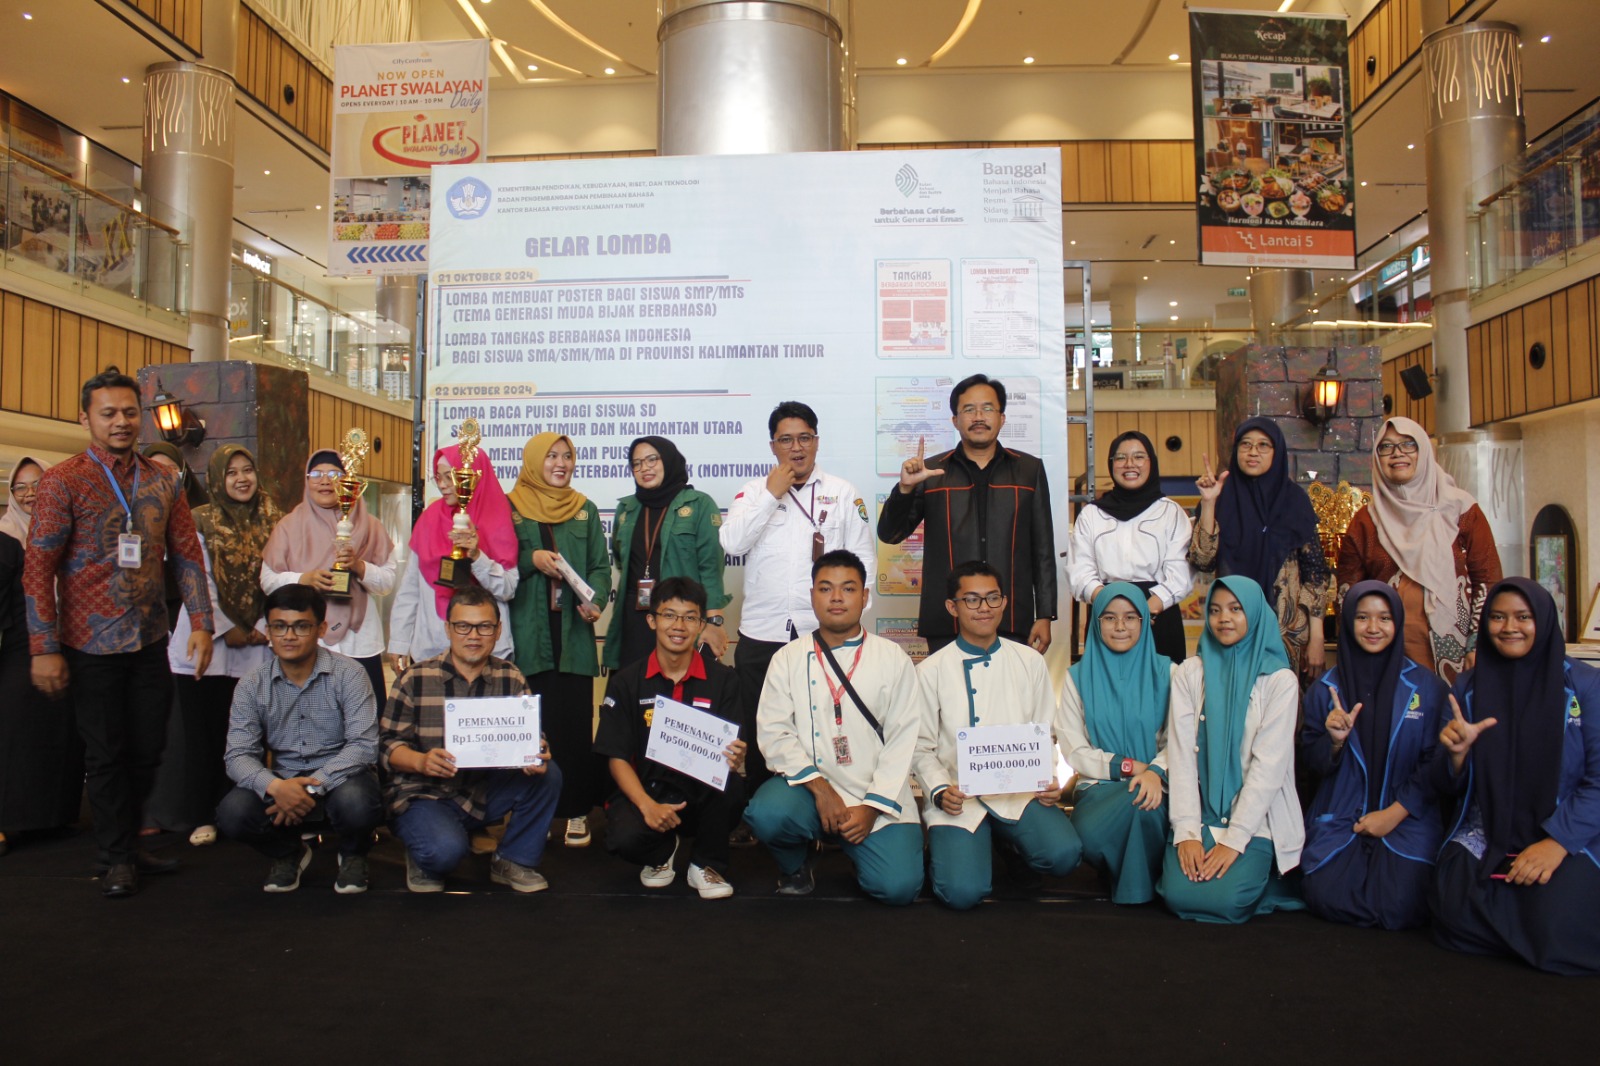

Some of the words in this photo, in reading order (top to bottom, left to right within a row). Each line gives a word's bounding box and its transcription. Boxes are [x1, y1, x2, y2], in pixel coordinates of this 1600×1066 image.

[1255, 30, 1287, 41] Kecapi
[377, 71, 408, 81] NOW
[412, 69, 444, 80] OPEN
[341, 83, 398, 98] PLANET
[400, 79, 483, 96] SWALAYAN
[450, 90, 482, 113] Daily
[402, 121, 466, 144] PLANET
[403, 145, 438, 153] SWALAYAN
[438, 142, 467, 157] Daily
[982, 162, 1046, 178] Bangga!
[497, 184, 541, 192] KEMENTERIAN
[542, 183, 581, 191] PENDIDIKAN,
[582, 182, 627, 190] KEBUDAYAAN,
[983, 187, 1012, 195] Menjadi
[521, 194, 573, 202] PENGEMBANGAN
[589, 192, 626, 200] PEMBINAAN
[497, 206, 523, 214] KANTOR
[551, 204, 581, 212] PROVINSI
[582, 203, 623, 211] KALIMANTAN
[983, 206, 1008, 215] Sidang
[874, 216, 900, 224] untuk
[902, 215, 938, 224] Generasi
[940, 215, 964, 223] Emas
[1285, 219, 1324, 227] Nusantara
[525, 236, 590, 258] GELAR
[596, 233, 672, 256] LOMBA
[1260, 234, 1302, 247] Lantai
[1305, 236, 1314, 247] 5
[438, 273, 452, 283] 21
[453, 272, 502, 282] OKTOBER
[504, 271, 533, 281] 2024
[893, 271, 932, 281] TANGKAS
[446, 290, 488, 306] LOMBA
[491, 289, 554, 305] MEMBUAT
[557, 288, 604, 302] POSTER
[607, 287, 636, 302] BAGI
[640, 286, 680, 301] SISWA
[684, 285, 744, 301] SMP/MTs
[452, 307, 492, 323] (TEMA
[494, 306, 553, 321] GENERASI
[557, 305, 594, 320] MUDA
[598, 304, 635, 318] BIJAK
[638, 302, 717, 318] BERBAHASA)
[445, 331, 487, 346] LOMBA
[491, 330, 545, 345] TANGKAS
[549, 329, 621, 344] BERBAHASA
[625, 328, 691, 342] INDONESIA
[452, 349, 480, 364] BAGI
[484, 348, 524, 364] SISWA
[527, 346, 615, 363] SMA/SMK/MA
[620, 347, 632, 361] DI
[636, 346, 694, 360] PROVINSI
[698, 344, 779, 360] KALIMANTAN
[783, 343, 824, 358] TIMUR
[435, 387, 451, 396] 22
[452, 385, 501, 396] OKTOBER
[503, 385, 532, 395] 2024
[444, 406, 485, 420] LOMBA
[490, 406, 521, 419] BACA
[526, 405, 558, 418] PUISI
[562, 404, 591, 418] BAGI
[596, 404, 636, 418] SISWA
[640, 403, 656, 417] SD
[546, 422, 586, 436] TIMUR
[591, 422, 615, 436] DAN
[620, 422, 699, 435] KALIMANTAN
[703, 421, 742, 434] UTARA
[602, 446, 630, 460] PUIS
[458, 717, 515, 727] PEMENANG
[518, 716, 525, 725] II
[664, 716, 715, 744] PEMENANG
[717, 738, 724, 746] V
[452, 732, 532, 745] Rp1.500.000,00
[660, 731, 722, 763] Rp500.000,00
[969, 743, 1026, 754] PEMENANG
[1029, 742, 1040, 751] VI
[970, 758, 1041, 772] Rp400.000,00
